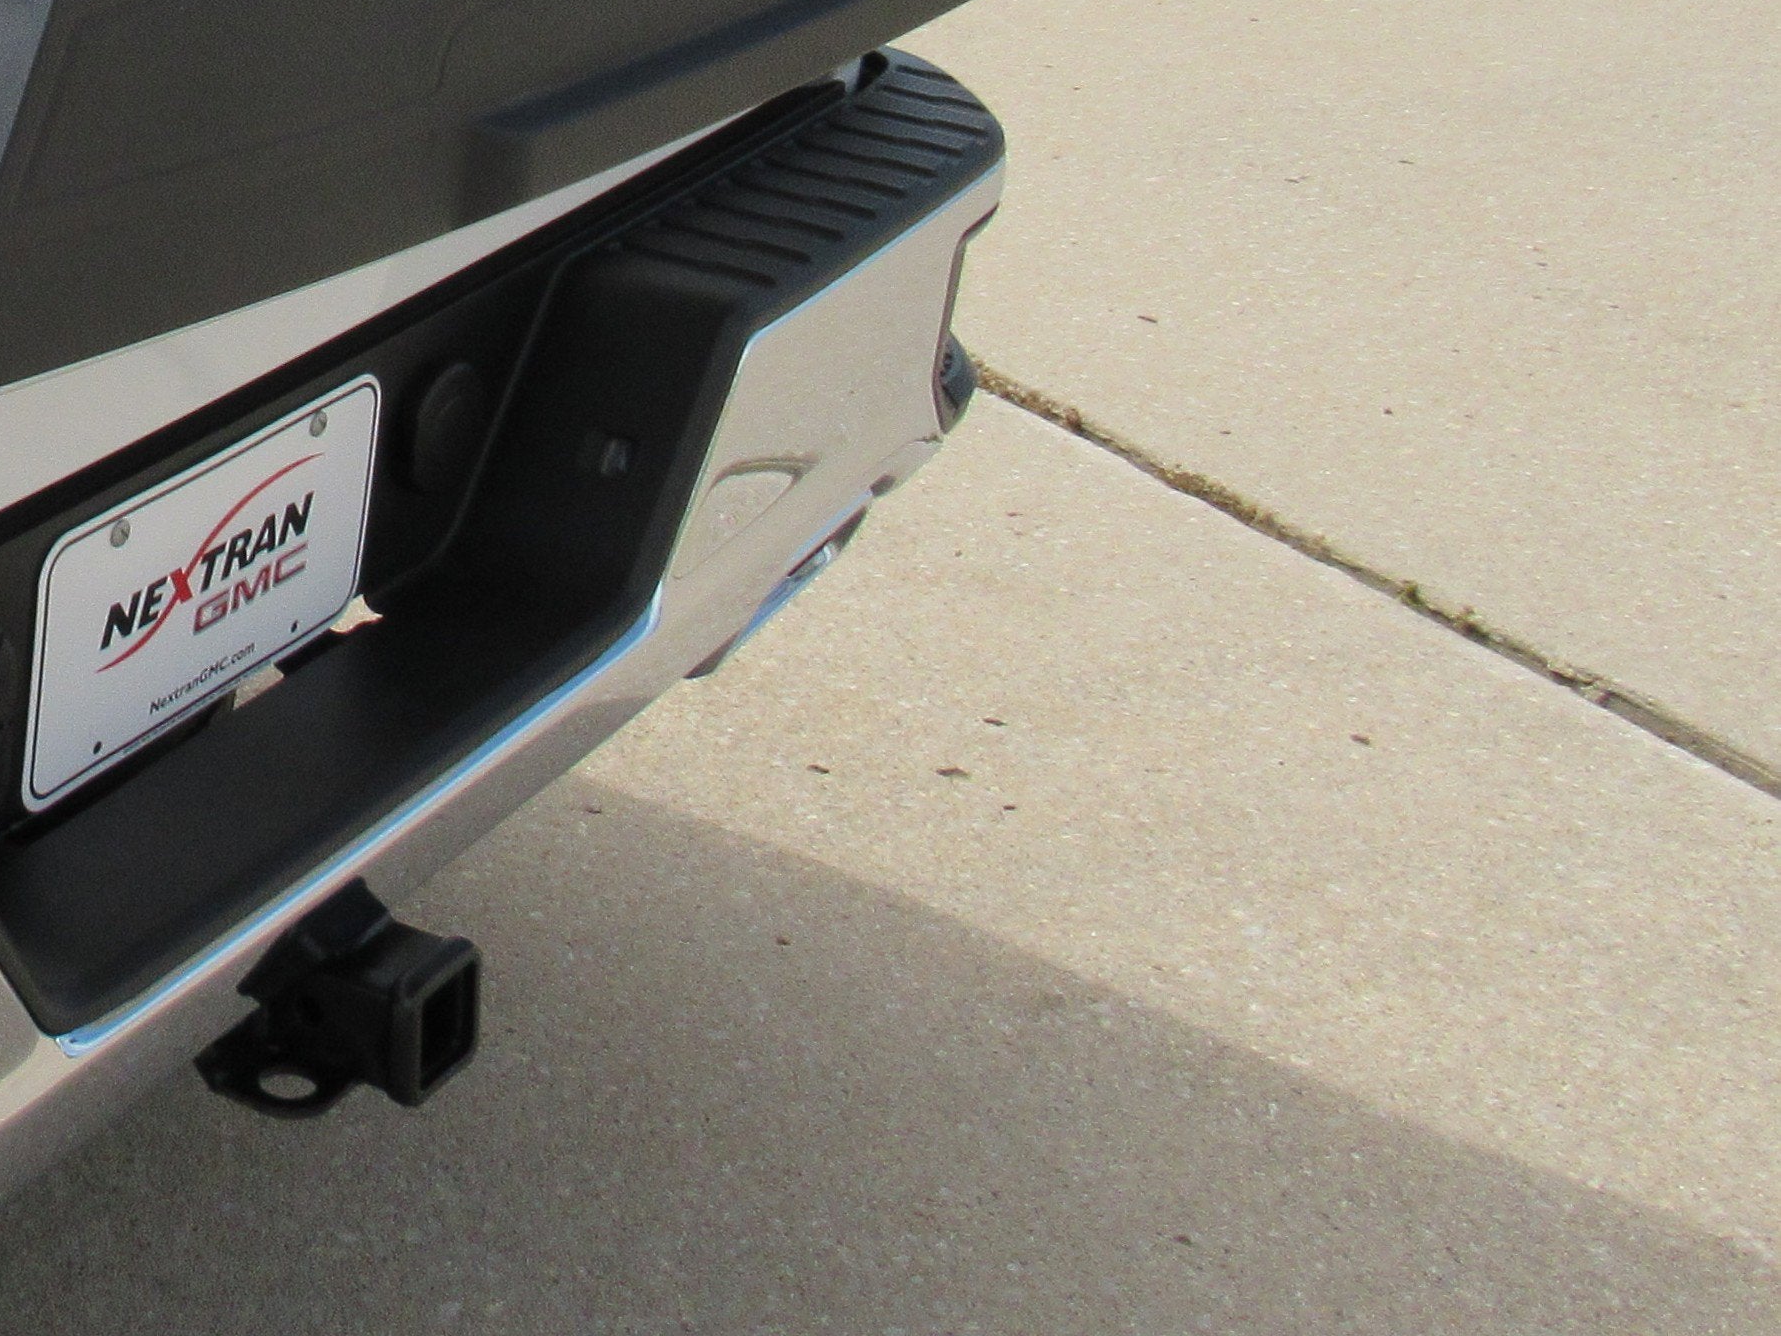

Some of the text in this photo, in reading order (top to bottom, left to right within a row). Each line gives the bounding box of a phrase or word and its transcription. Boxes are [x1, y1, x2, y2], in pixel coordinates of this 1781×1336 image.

[100, 490, 315, 651] NEXTRAN
[193, 543, 308, 635] GMC
[148, 641, 256, 715] NextranGMC.com
